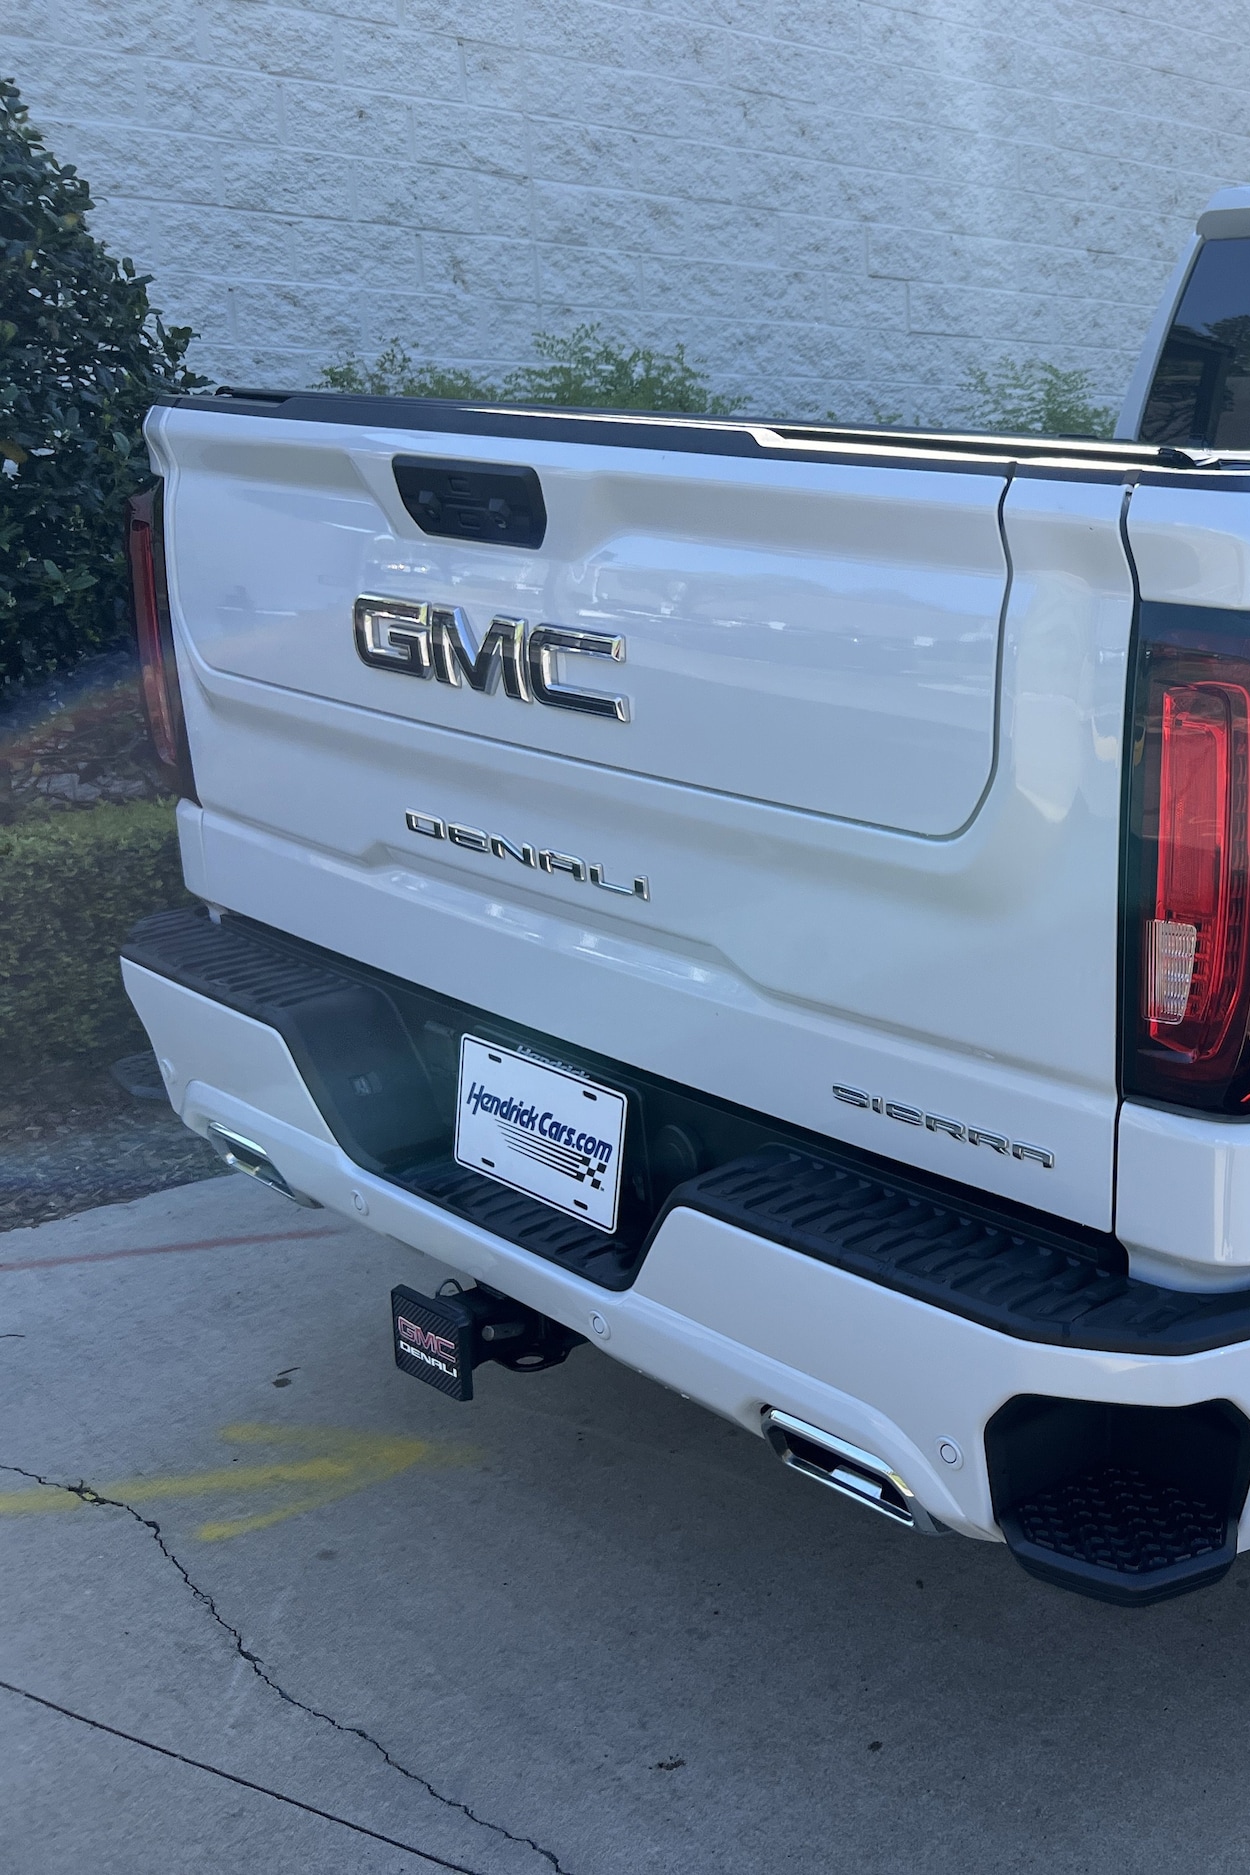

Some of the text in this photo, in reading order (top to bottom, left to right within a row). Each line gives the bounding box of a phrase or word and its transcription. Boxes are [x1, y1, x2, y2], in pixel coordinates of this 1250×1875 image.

[354, 590, 631, 723] GMC
[405, 806, 651, 901] DENALI
[832, 1082, 1055, 1169] SIERRA
[398, 1316, 456, 1363] GMC
[400, 1340, 458, 1378] DENALI
